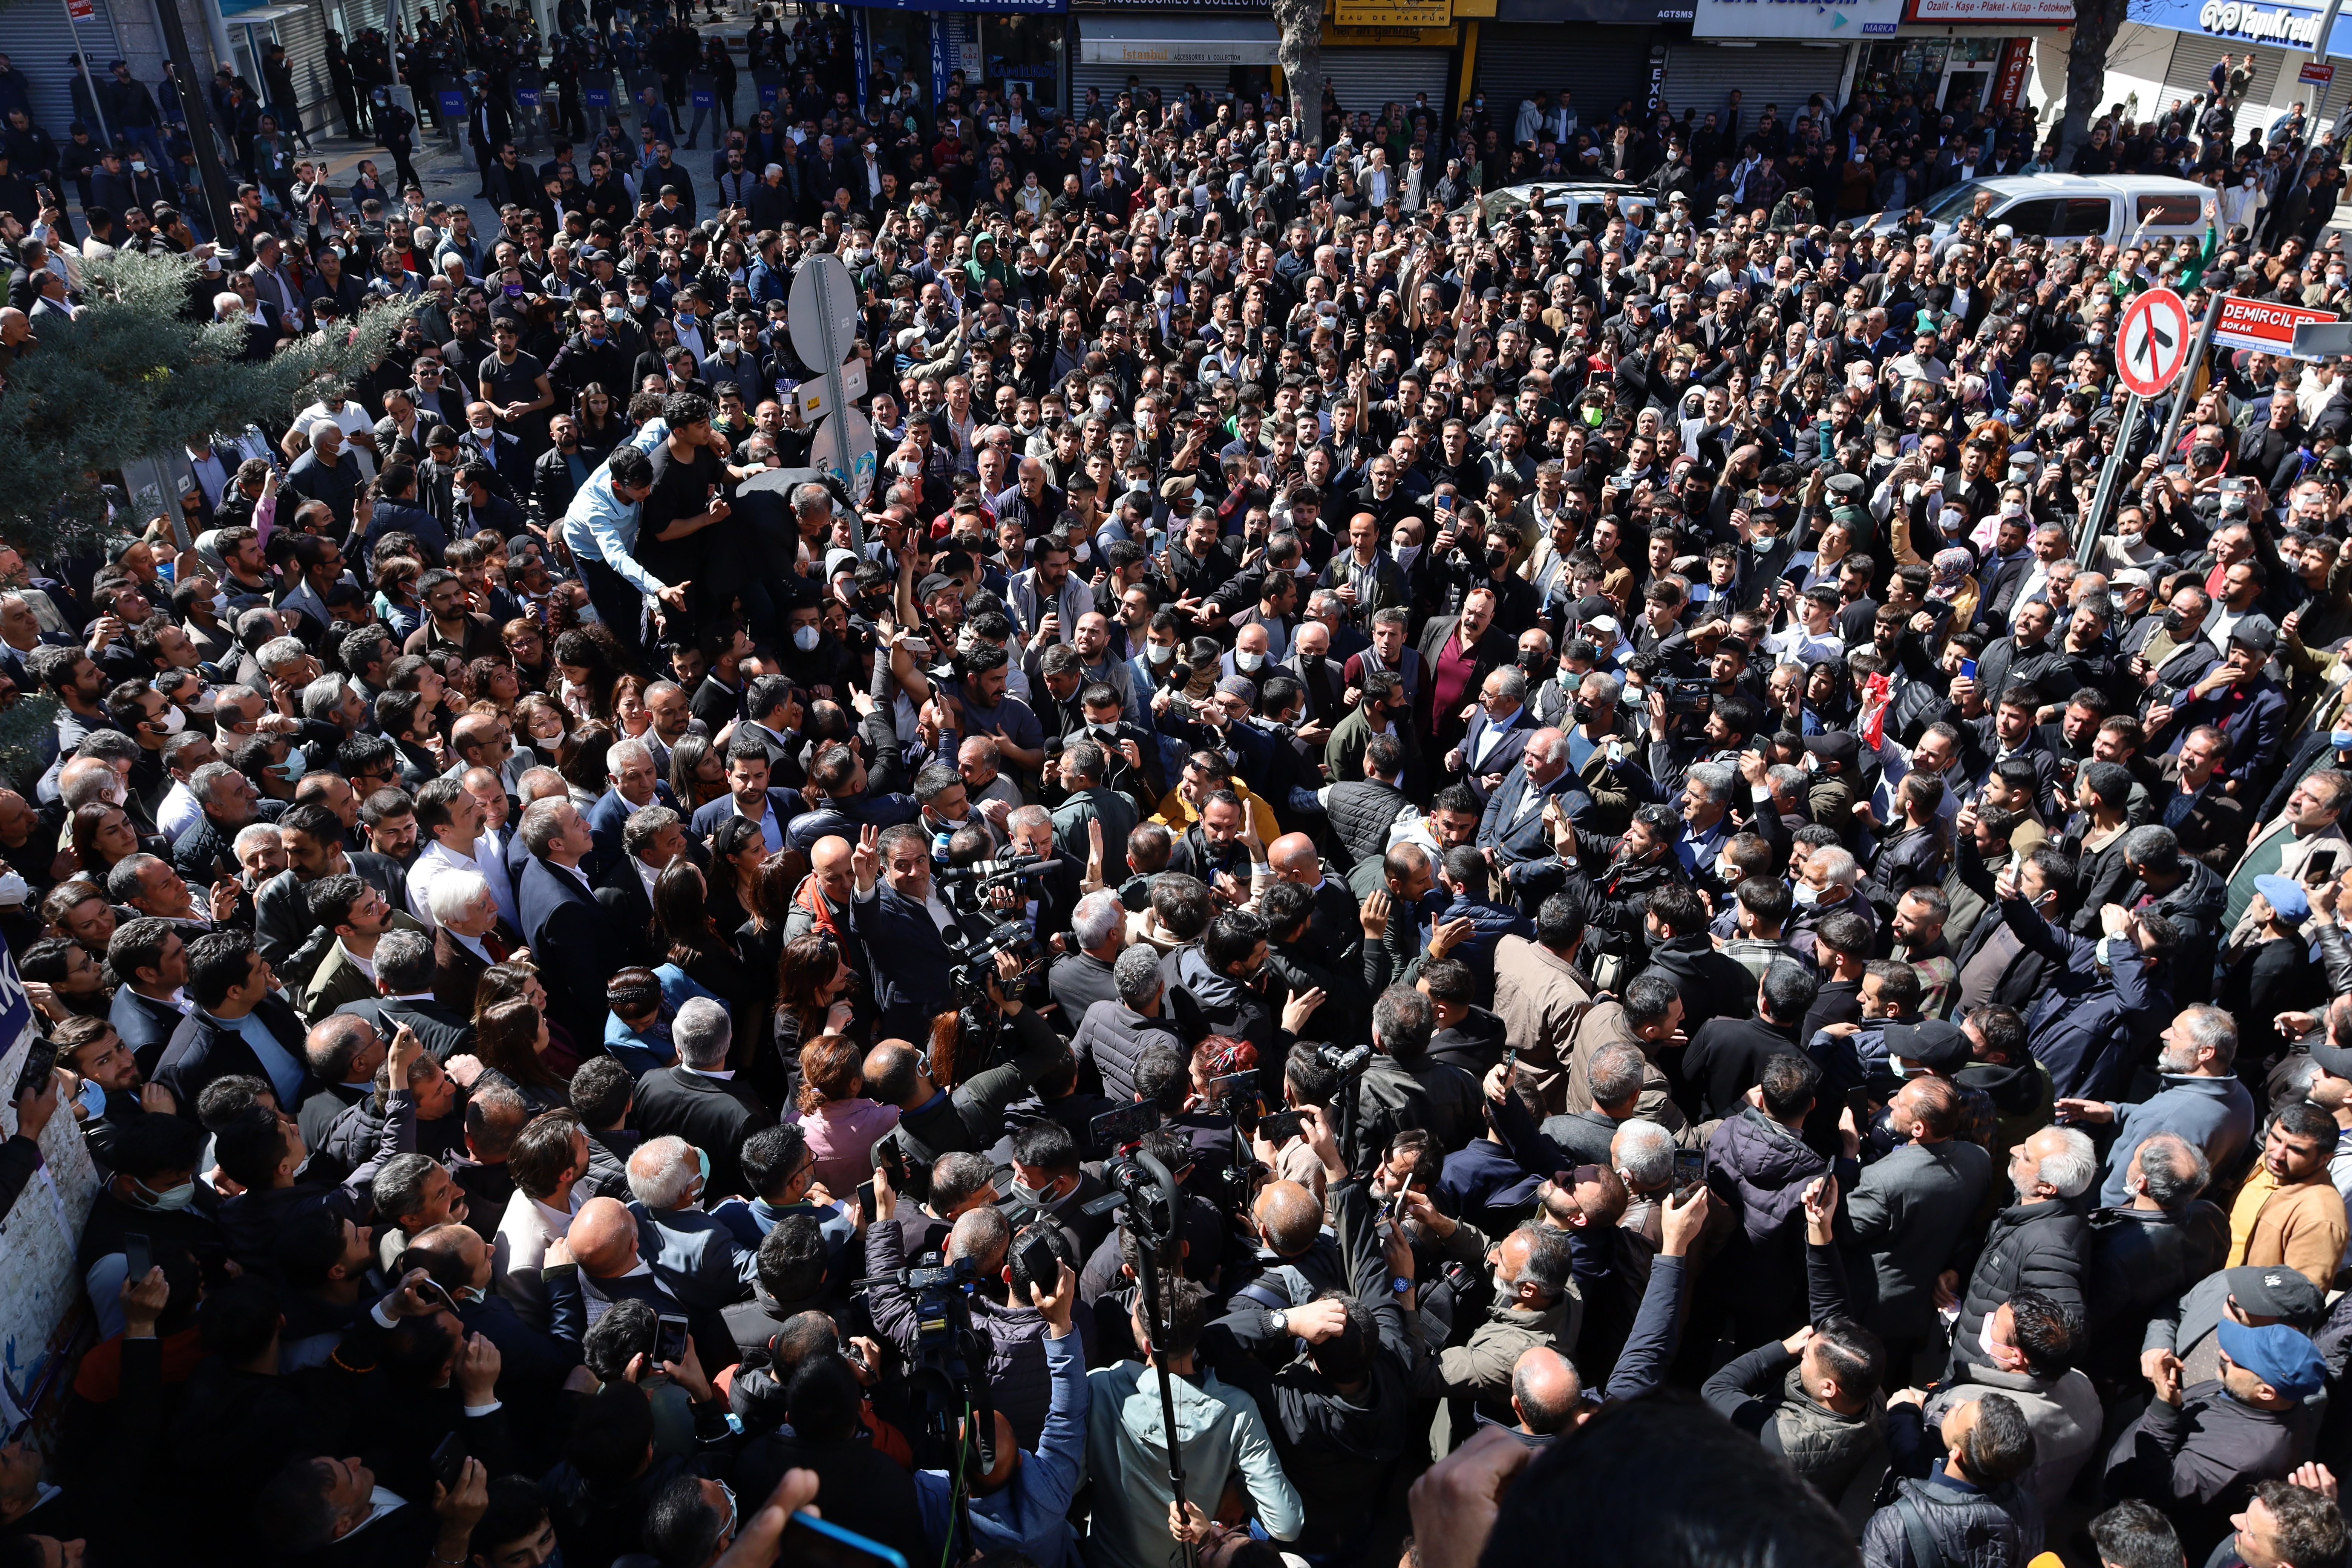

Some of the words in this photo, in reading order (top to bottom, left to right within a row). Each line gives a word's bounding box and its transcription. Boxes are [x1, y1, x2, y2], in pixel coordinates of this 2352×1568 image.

[1657, 10, 1694, 18] AGTSMS
[1927, 1, 1949, 11] Ozalit
[1955, 1, 1974, 13] Kaşe
[1981, 1, 2004, 11] Plaket
[2011, 2, 2031, 14] Kitap
[2238, 3, 2322, 43] YapıKredi
[1122, 46, 1168, 60] İstanbul
[2221, 321, 2253, 333] SOKAK
[2222, 338, 2256, 349] BÜYÜKŞEHİR
[2256, 344, 2286, 354] BELEDİYESİ
